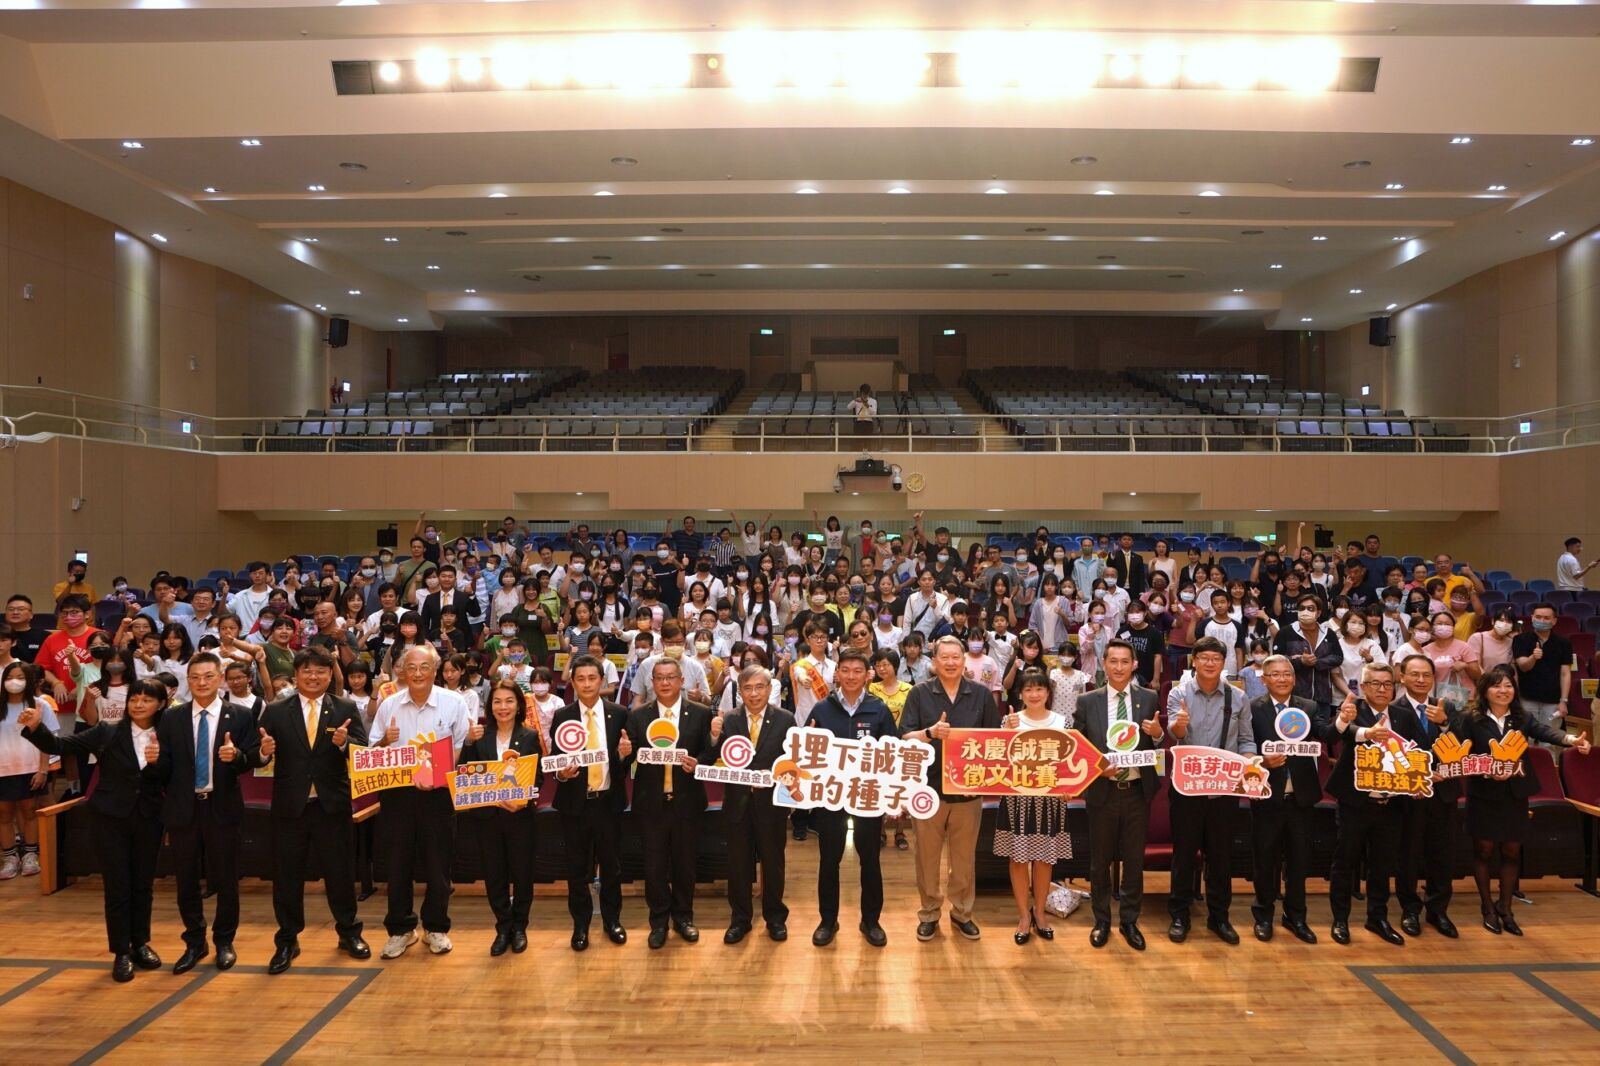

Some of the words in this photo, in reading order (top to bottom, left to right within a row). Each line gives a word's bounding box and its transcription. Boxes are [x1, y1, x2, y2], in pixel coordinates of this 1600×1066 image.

[355, 747, 415, 769] 誠實打開
[639, 750, 687, 764] 永義房屋
[789, 733, 929, 783] 埋下誠實
[961, 737, 1061, 761] 永慶誠實
[1264, 743, 1319, 754] 台慶不動產
[543, 751, 607, 770] 永慶不動產
[1183, 757, 1242, 779] 萌芽吧
[1439, 757, 1525, 777] 最佳誠實代言人
[354, 769, 412, 794] 信任的大門
[456, 773, 497, 788] 我走在
[963, 763, 1058, 787] 徵文比賽
[1184, 781, 1239, 791] 誠實的種子
[1357, 770, 1429, 793] 讓我強大
[455, 786, 539, 806] 誠實的道路上
[810, 775, 908, 811] 的種子
